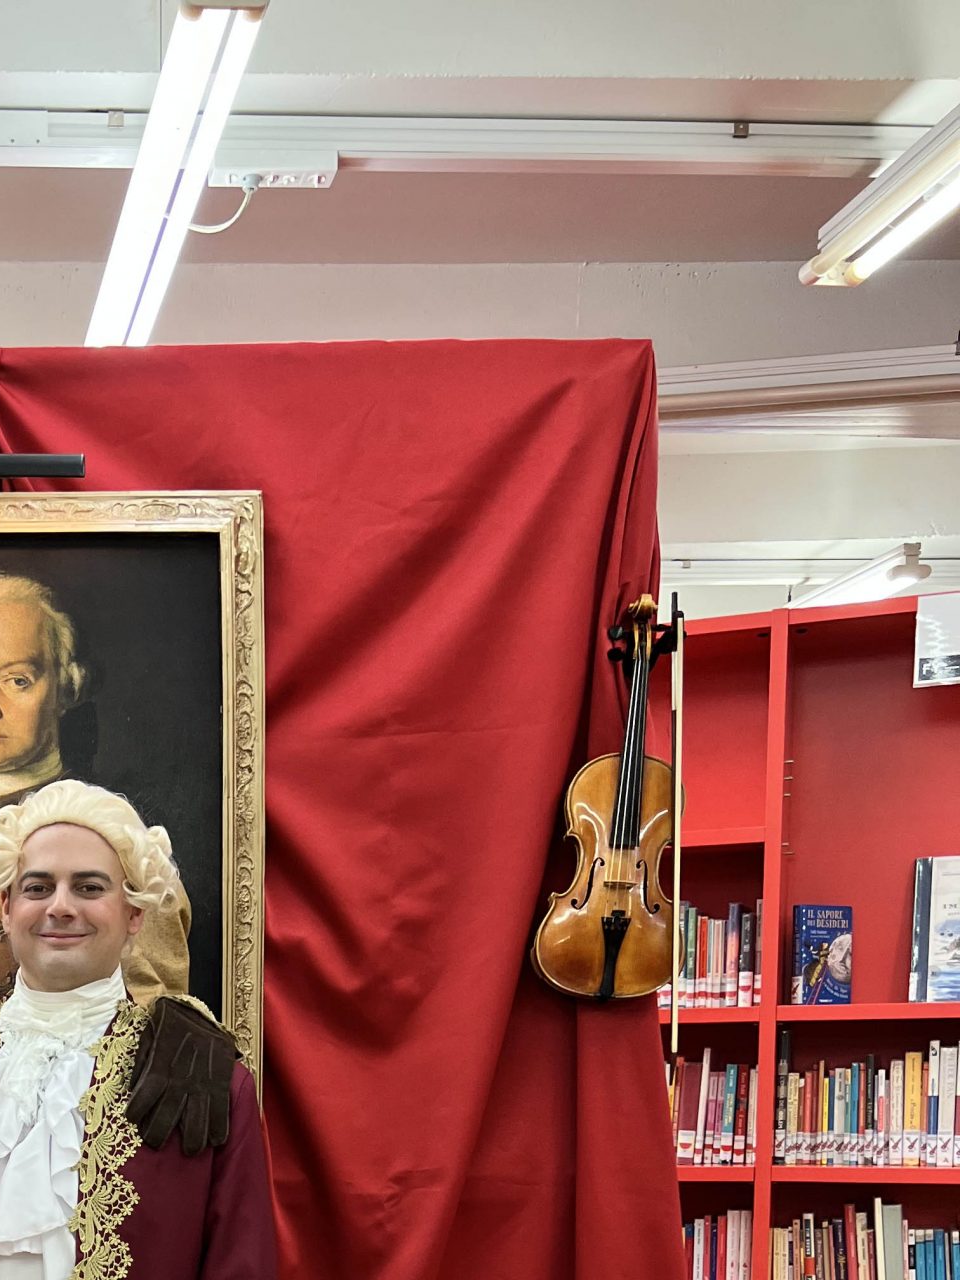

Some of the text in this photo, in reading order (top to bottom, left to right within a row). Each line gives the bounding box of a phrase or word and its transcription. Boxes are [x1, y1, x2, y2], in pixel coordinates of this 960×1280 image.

[807, 909, 843, 919] IL SAPORE
[816, 919, 849, 928] DESIDERI
